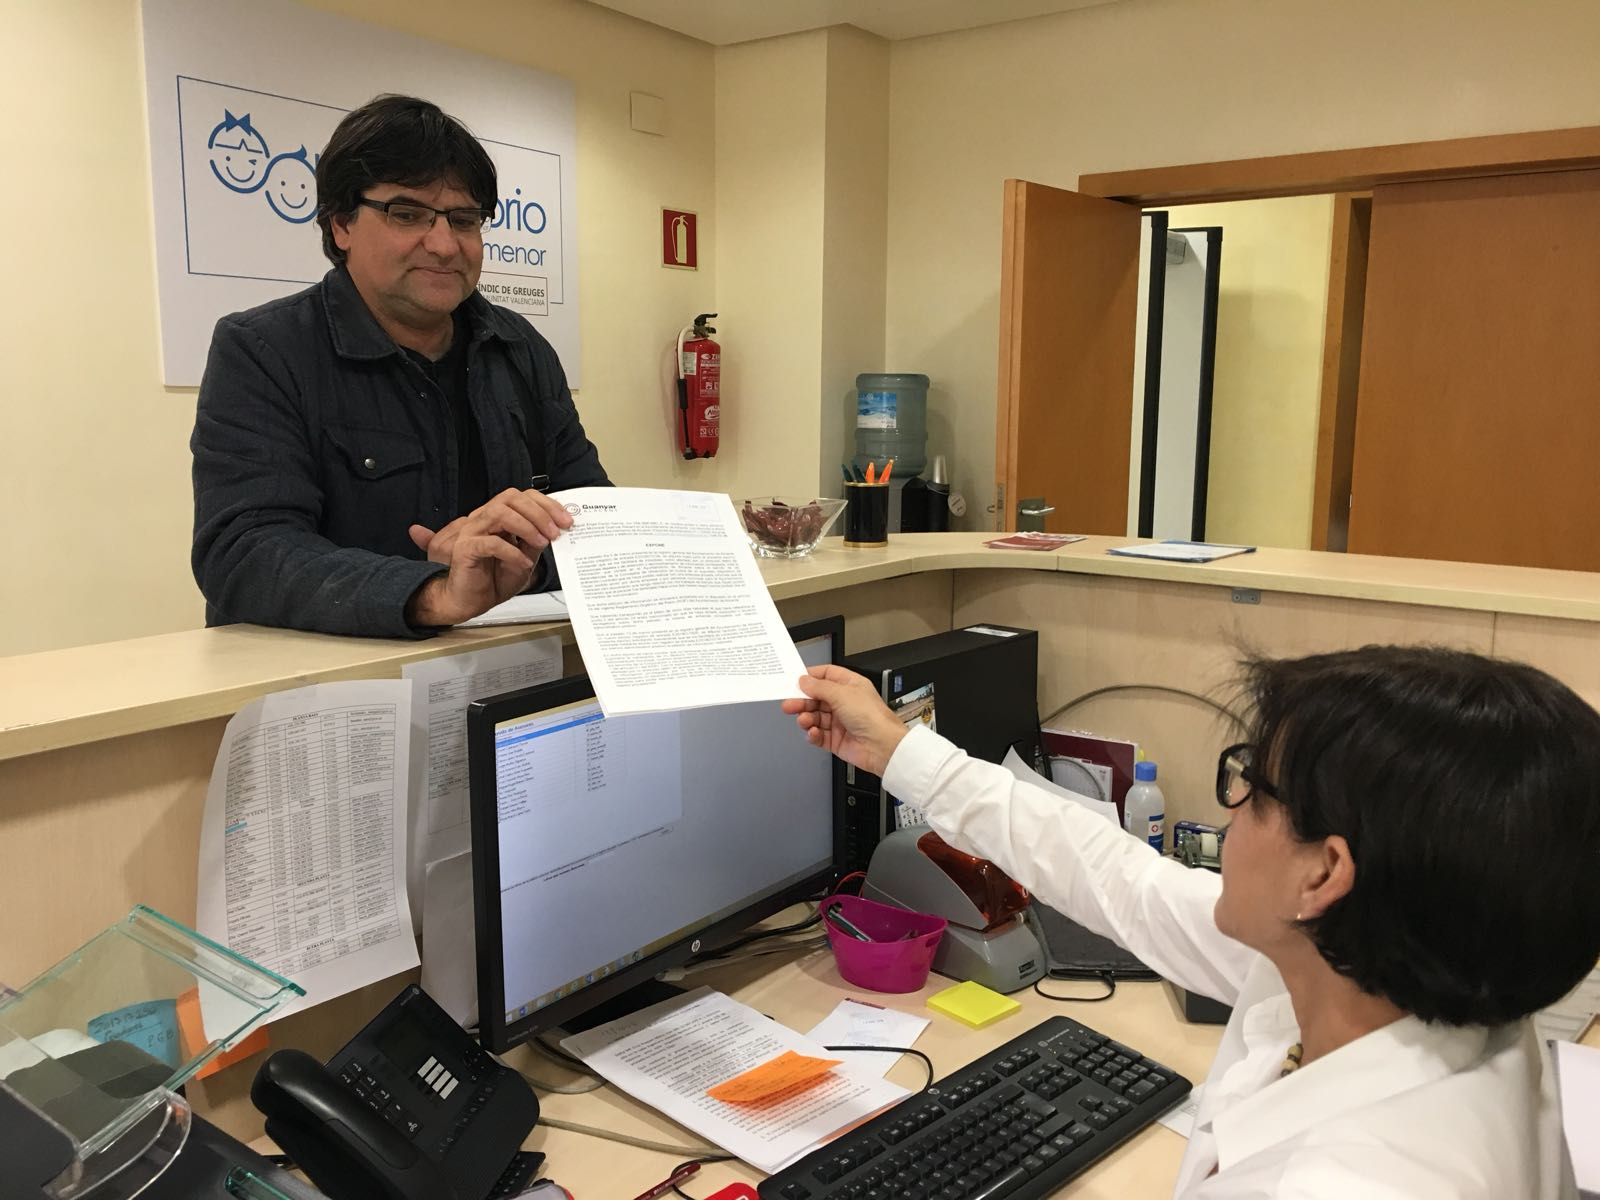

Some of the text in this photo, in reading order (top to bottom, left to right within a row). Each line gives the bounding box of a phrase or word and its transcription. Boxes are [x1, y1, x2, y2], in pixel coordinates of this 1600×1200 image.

[482, 242, 547, 266] menor
[477, 281, 545, 297] ÍNDIC DE GREUGES
